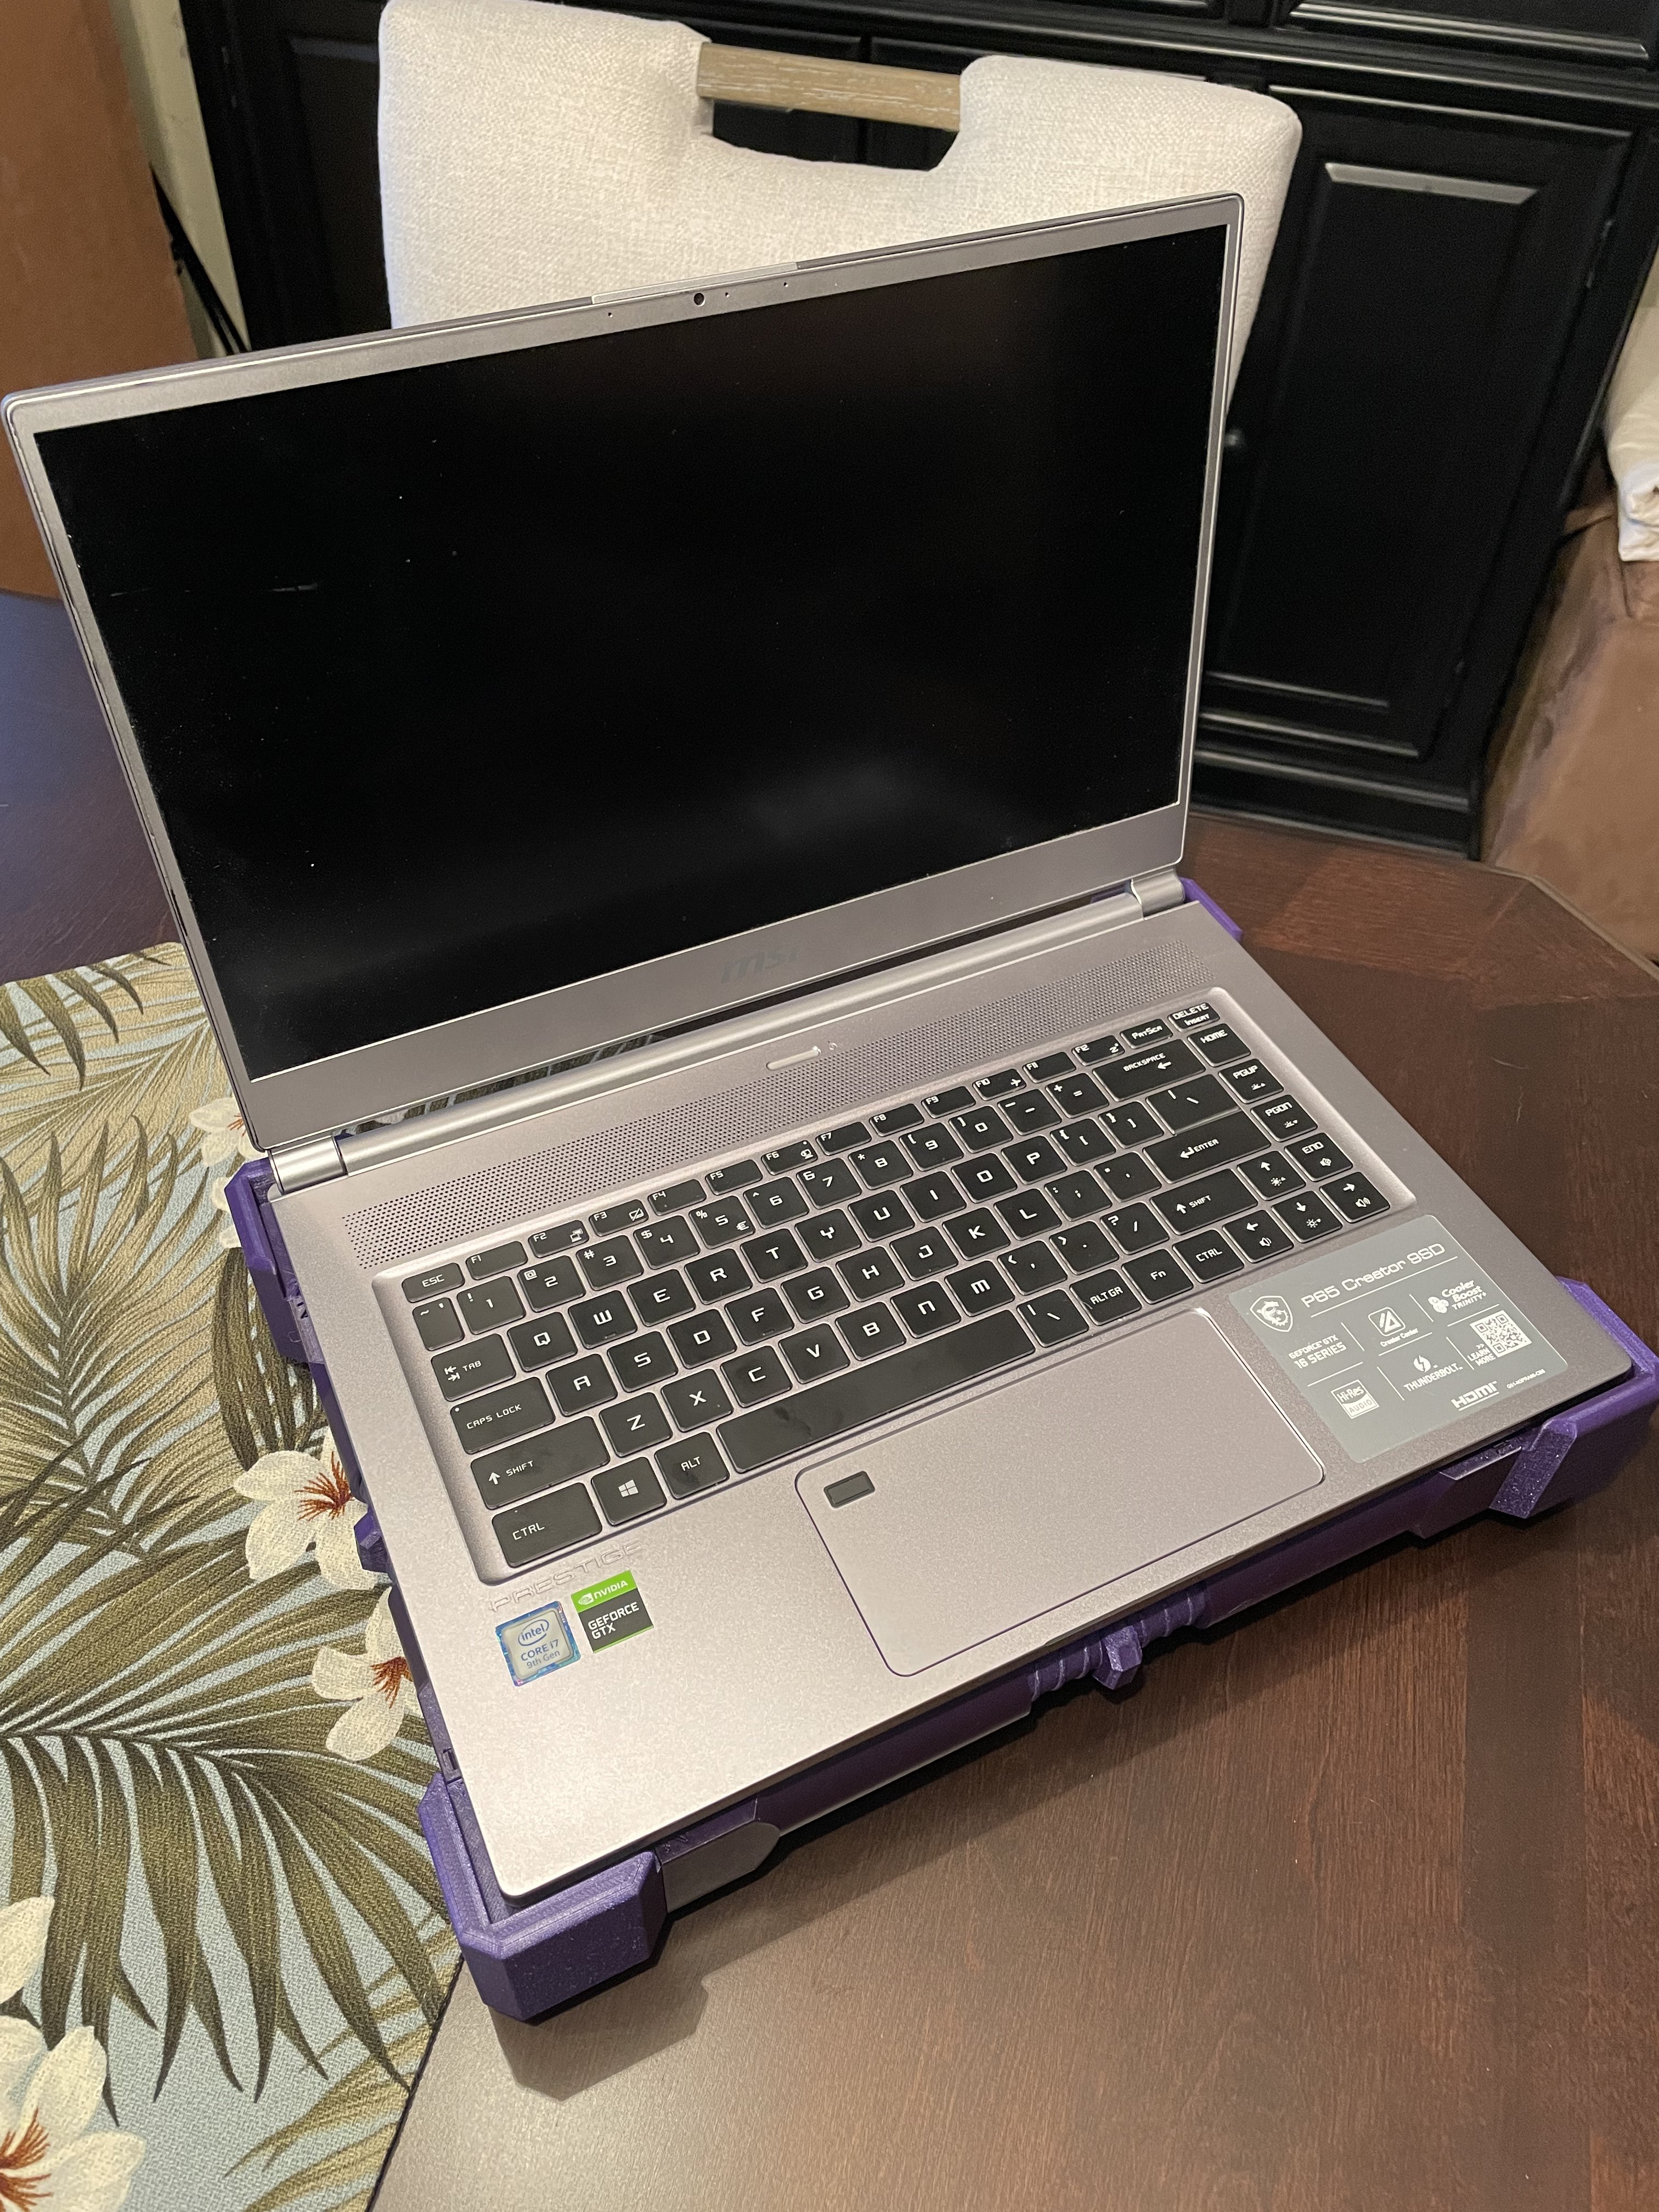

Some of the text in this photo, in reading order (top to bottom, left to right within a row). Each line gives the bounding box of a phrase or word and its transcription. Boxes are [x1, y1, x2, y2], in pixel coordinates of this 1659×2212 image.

[1172, 1003, 1209, 1020] DELETE
[1200, 1029, 1227, 1043] HOME
[1075, 1044, 1089, 1053] F12
[1026, 1062, 1038, 1070] F11
[1123, 1053, 1166, 1071] BACKSPACE
[1233, 1065, 1257, 1079] PGUP
[975, 1078, 990, 1088] F10
[926, 1096, 939, 1104] F9
[1265, 1102, 1292, 1116] PGDN
[873, 1114, 886, 1122] F8
[975, 1122, 988, 1132] 0
[821, 1132, 832, 1141] F7
[926, 1140, 938, 1150] 9
[1193, 1139, 1218, 1152] ENTER
[1302, 1142, 1324, 1154] END
[766, 1152, 779, 1160] F6
[875, 1158, 888, 1167] 8
[1026, 1153, 1040, 1164] P
[710, 1171, 723, 1180] F5
[822, 1176, 832, 1187] 7
[977, 1170, 992, 1182] O
[652, 1191, 666, 1200] F4
[770, 1195, 782, 1205] 6
[930, 1190, 938, 1200] I
[1189, 1195, 1211, 1207] SHIFT
[594, 1211, 607, 1221] F3
[696, 1210, 708, 1218] %
[874, 1207, 890, 1220] U
[1019, 1210, 1037, 1219] L
[715, 1215, 728, 1226] 5
[1108, 1216, 1119, 1225] ?
[533, 1233, 546, 1242] F2
[641, 1230, 652, 1239] $
[660, 1235, 674, 1243] 4
[820, 1227, 834, 1238] Y
[968, 1226, 985, 1239] K
[1058, 1237, 1066, 1245] >
[584, 1250, 594, 1259] #
[766, 1247, 778, 1259] T
[919, 1245, 933, 1258] J
[1196, 1249, 1222, 1261] CTRL
[471, 1255, 481, 1263] F1
[603, 1256, 616, 1266] 3
[1008, 1255, 1017, 1263] <
[524, 1269, 537, 1280] @
[710, 1268, 727, 1282] R
[862, 1265, 879, 1279] H
[1150, 1271, 1166, 1280] Fn
[1301, 1243, 1446, 1308] P65 Creator 9SD
[422, 1274, 444, 1287] ESC
[545, 1276, 558, 1287] 2
[971, 1280, 990, 1294] M
[808, 1286, 823, 1300] G
[1090, 1286, 1123, 1304] ALT GR
[1441, 1280, 1474, 1297] Cooler
[1452, 1285, 1483, 1302] Boost
[653, 1289, 670, 1302] E
[486, 1299, 493, 1307] 1
[594, 1310, 612, 1324] W
[752, 1308, 764, 1322] F
[863, 1322, 880, 1336] B
[534, 1332, 550, 1346] Q
[693, 1330, 710, 1344] D
[1380, 1328, 1419, 1347] Creator Center
[806, 1344, 819, 1357] V
[1289, 1334, 1339, 1359] GEFORCE GTX
[634, 1352, 651, 1367] S
[1294, 1342, 1347, 1369] 16 SERIES
[1467, 1347, 1491, 1362] LEARN
[1475, 1353, 1496, 1366] MORE
[462, 1361, 481, 1371] TAB
[748, 1367, 765, 1381] C
[574, 1376, 591, 1390] A
[690, 1391, 706, 1406] X
[1336, 1386, 1364, 1402] Hi-Res
[1348, 1400, 1373, 1413] AUDIO
[467, 1404, 521, 1429] CAPS LOCK
[627, 1415, 645, 1430] Z
[506, 1460, 533, 1476] SHIFT
[681, 1457, 700, 1471] ALT
[513, 1523, 545, 1540] CTRL
[489, 1539, 643, 1612] PRESTIGE
[588, 1602, 640, 1630] GEFORCE
[521, 1623, 545, 1641] intel
[591, 1622, 616, 1639] GTX
[521, 1639, 559, 1662] CORE i7
[526, 1650, 560, 1669] 9th Gen
